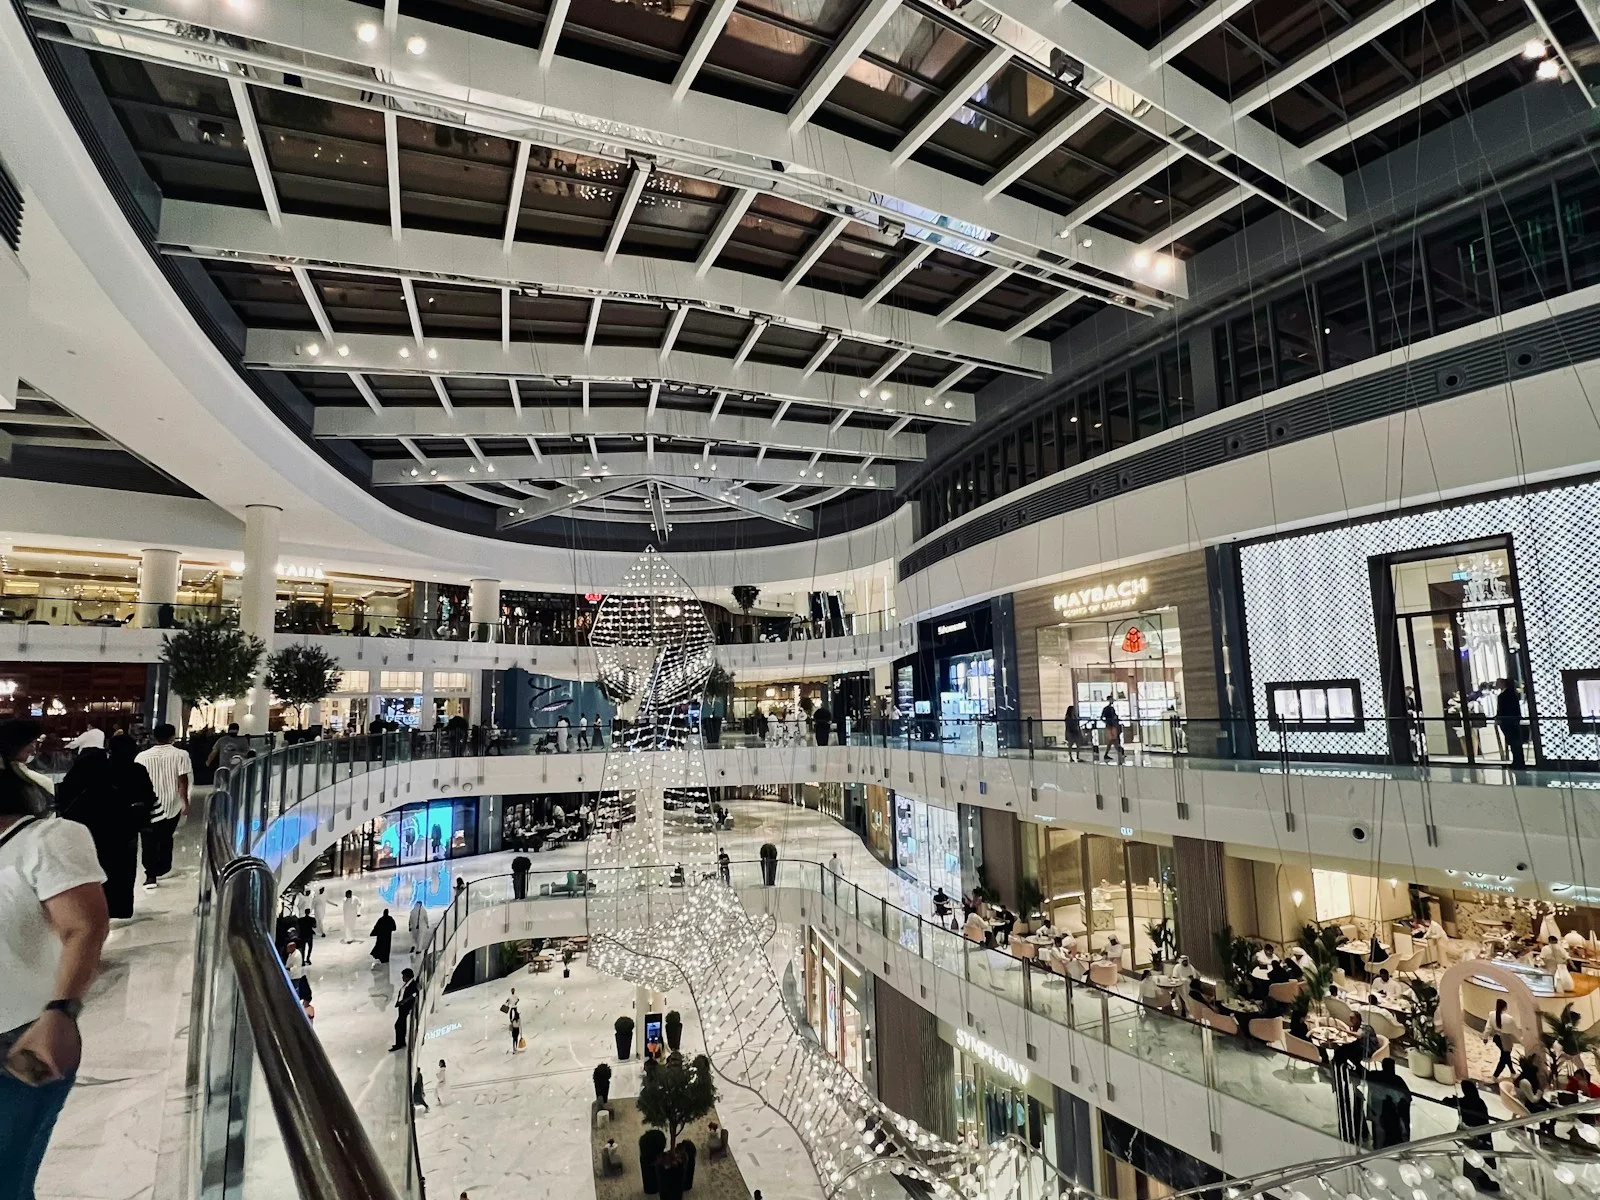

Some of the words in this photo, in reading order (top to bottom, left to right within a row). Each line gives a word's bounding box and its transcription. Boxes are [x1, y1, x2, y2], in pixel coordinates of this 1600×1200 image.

[1053, 577, 1148, 611] MAYBACH
[1101, 597, 1137, 612] LUXURY
[956, 1028, 1029, 1085] SYMPHONY
